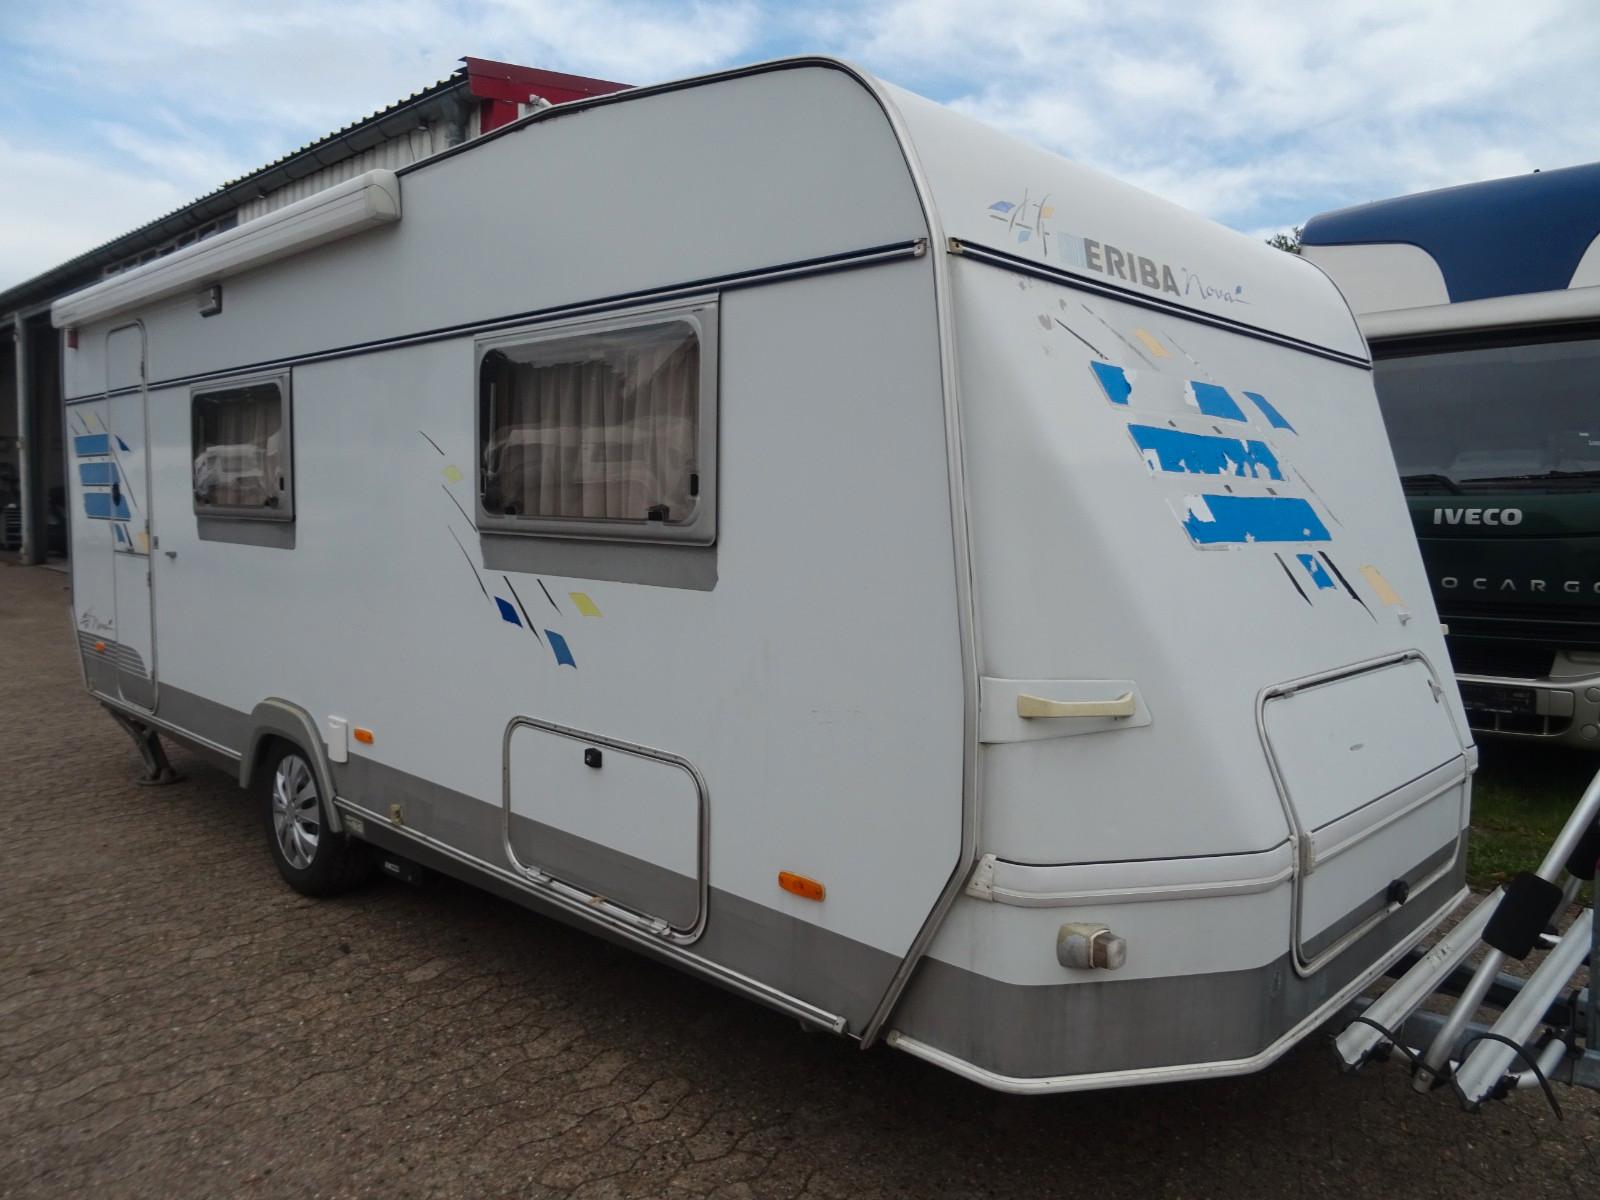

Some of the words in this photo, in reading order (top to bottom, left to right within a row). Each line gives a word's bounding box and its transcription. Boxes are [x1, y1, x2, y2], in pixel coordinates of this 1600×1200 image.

[1083, 237, 1181, 297] ERIBA
[1182, 267, 1250, 304] Nova
[1433, 508, 1523, 526] IVECO
